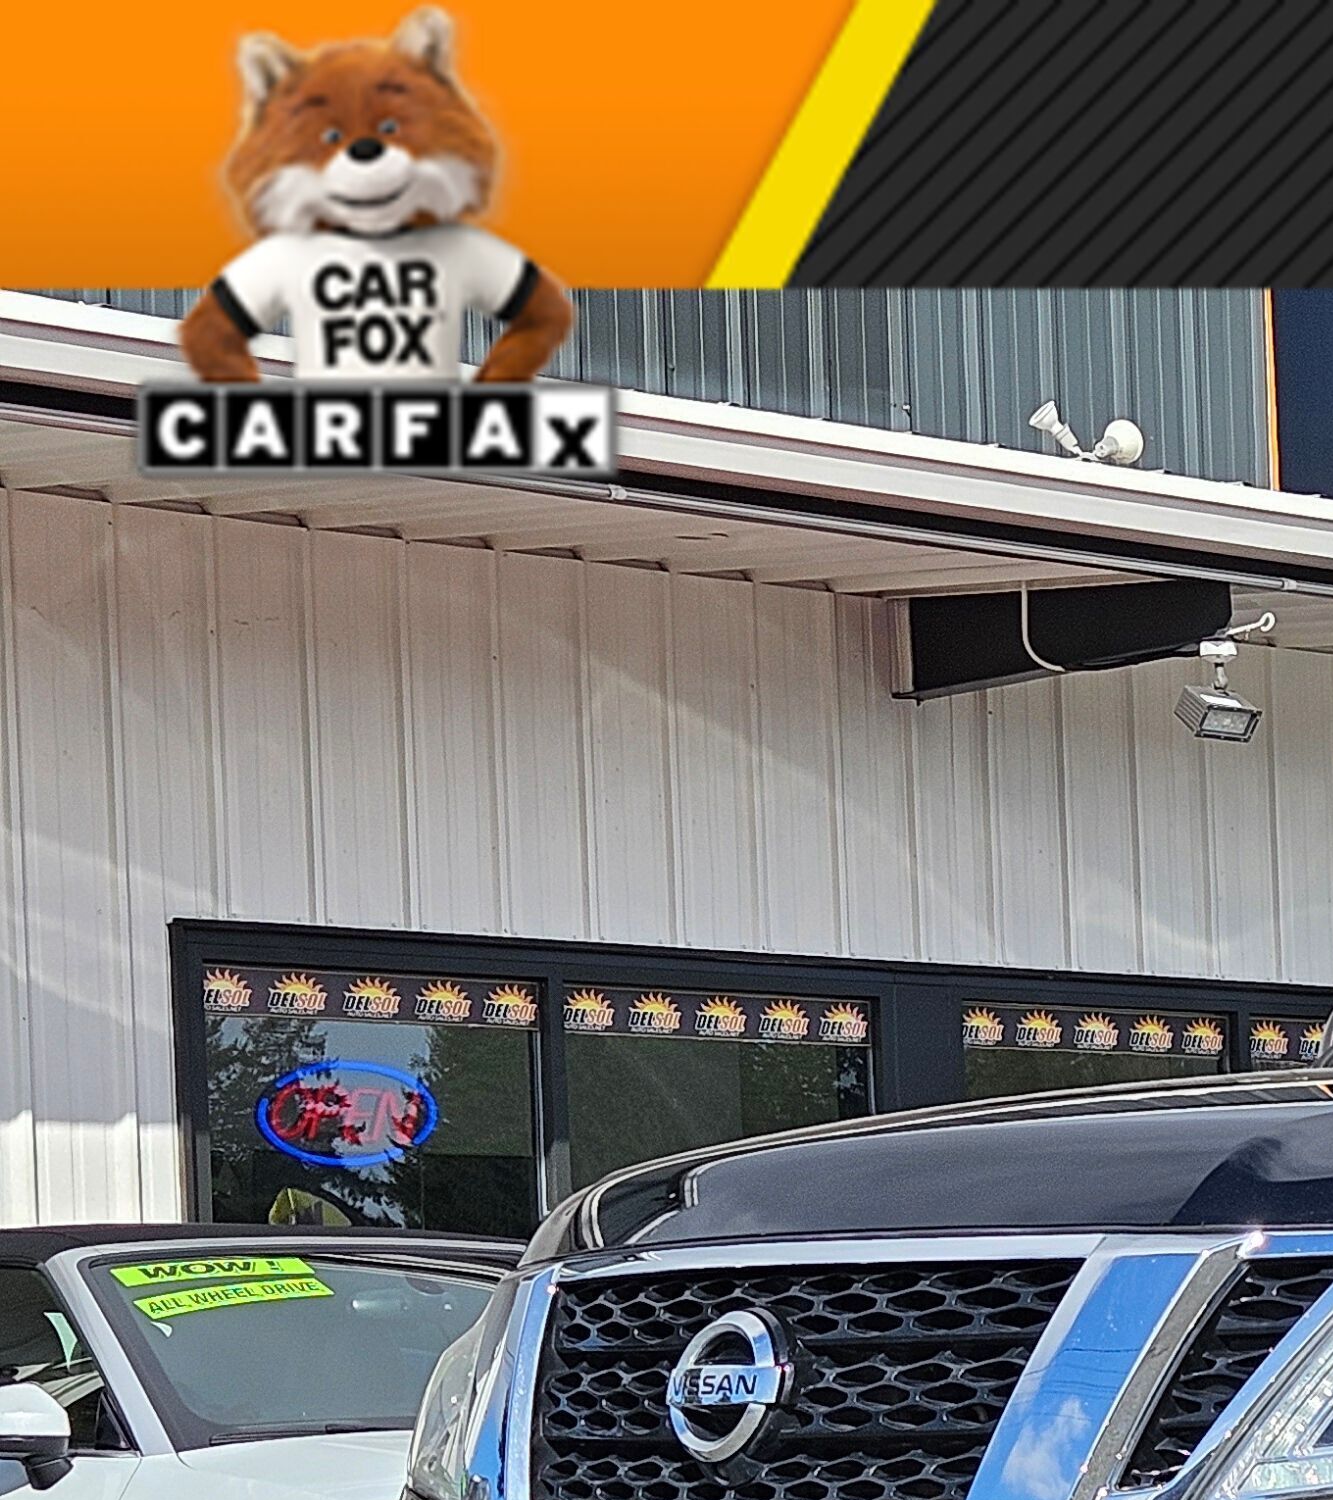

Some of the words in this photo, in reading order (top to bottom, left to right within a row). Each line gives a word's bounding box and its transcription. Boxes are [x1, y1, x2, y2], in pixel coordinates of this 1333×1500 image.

[270, 1082, 421, 1146] OPEN
[149, 1297, 186, 1314] ALL
[188, 1286, 259, 1306] WHEEL
[262, 1280, 321, 1296] DRIVE
